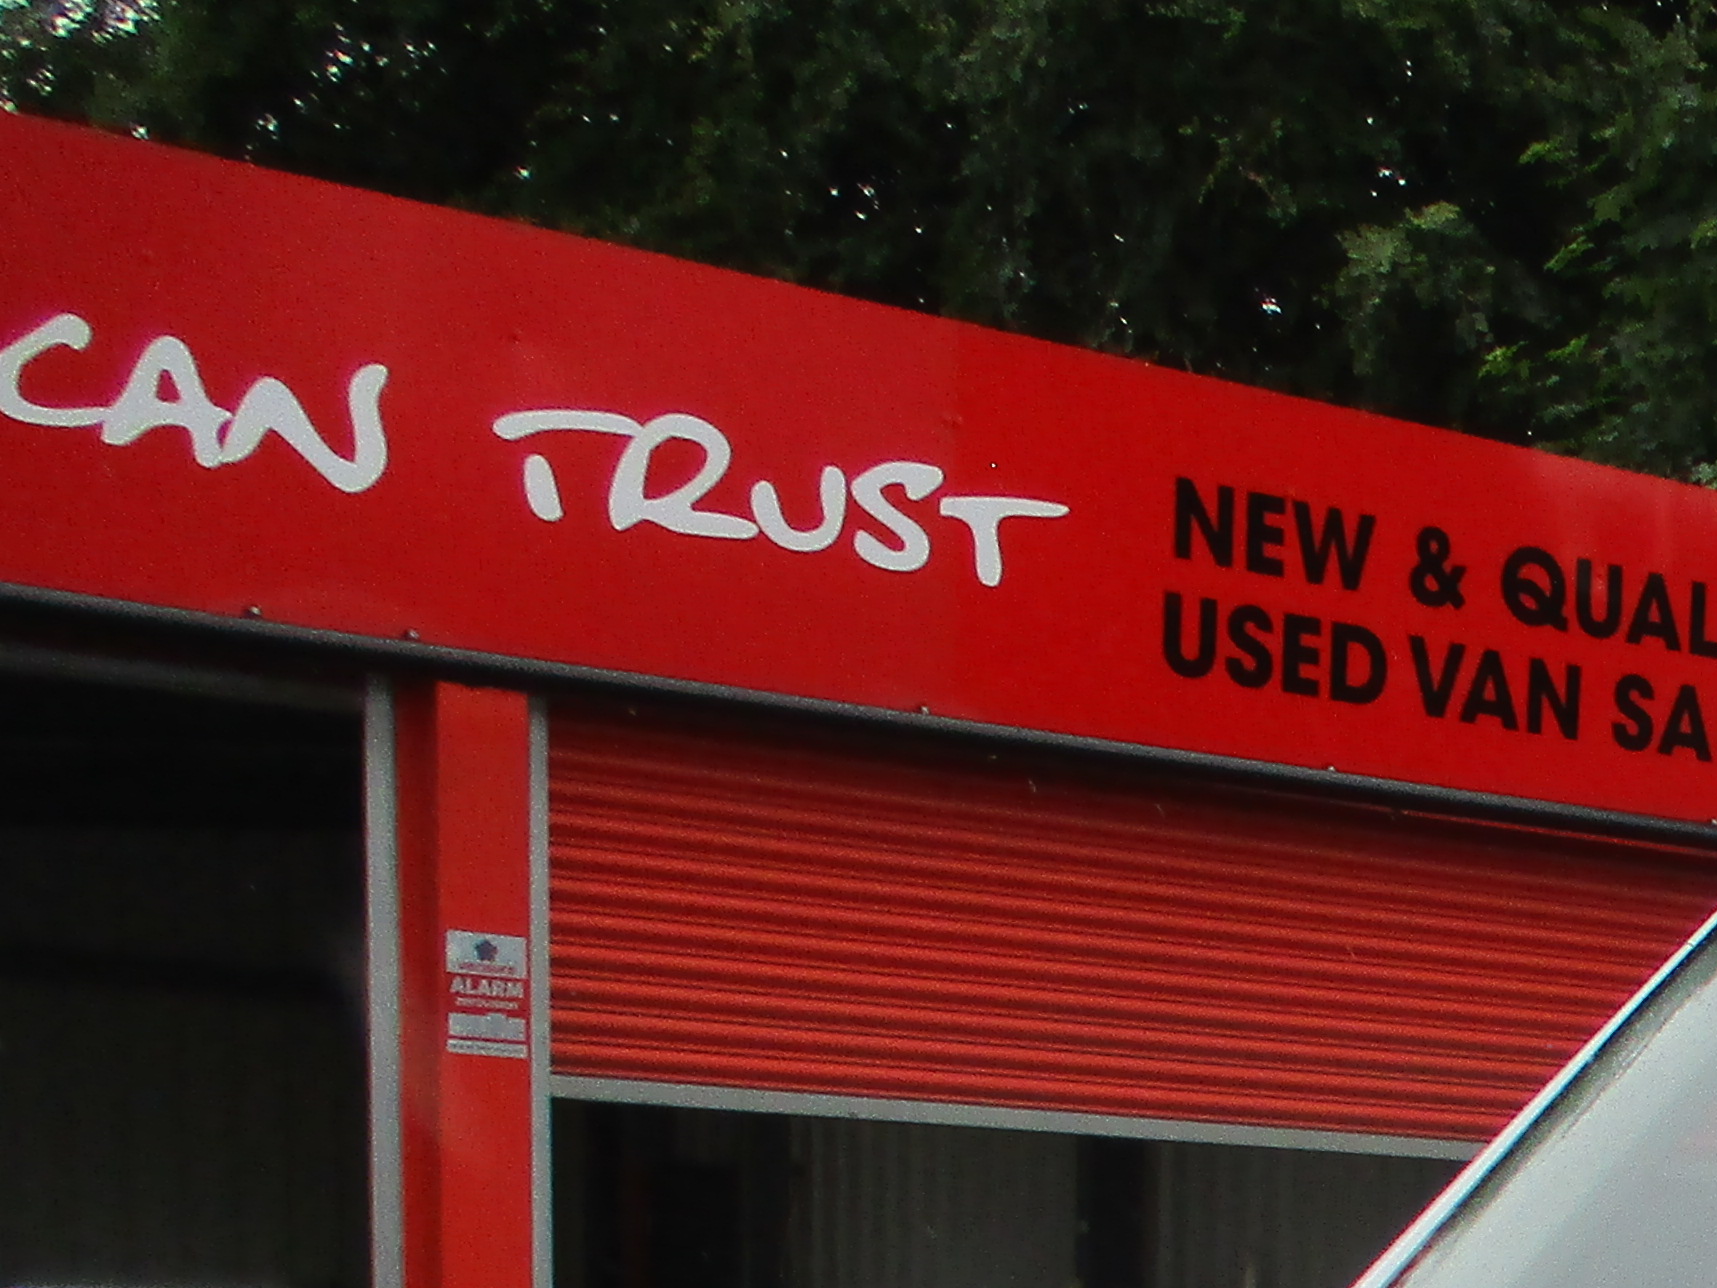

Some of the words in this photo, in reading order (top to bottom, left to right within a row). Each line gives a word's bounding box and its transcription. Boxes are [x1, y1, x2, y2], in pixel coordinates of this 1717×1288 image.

[0, 313, 389, 493] CAN
[493, 410, 1069, 586] TRUST
[1175, 478, 1375, 590] NEW
[1410, 527, 1465, 609] &
[1163, 591, 1388, 705] USED
[1410, 636, 1580, 739] VAN
[450, 977, 524, 998] ALARM
